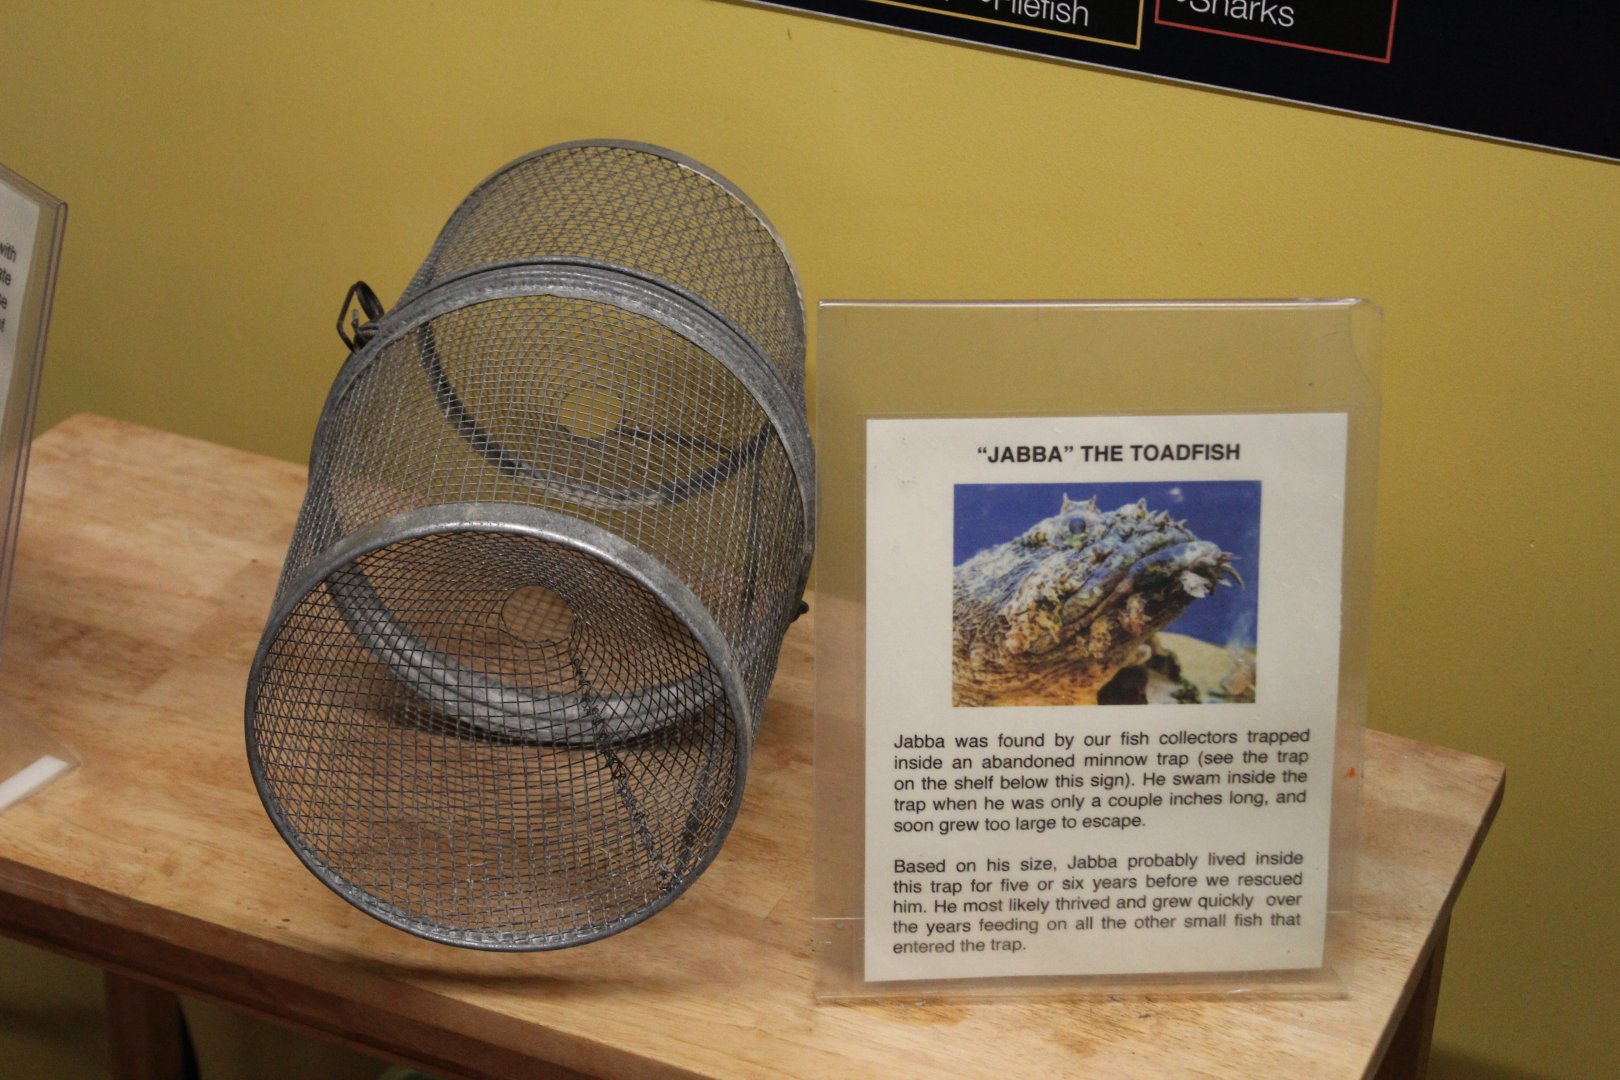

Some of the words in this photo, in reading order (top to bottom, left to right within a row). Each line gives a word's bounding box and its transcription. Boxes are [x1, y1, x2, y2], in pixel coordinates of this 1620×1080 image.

[978, 445, 1074, 463] “JABBA”
[1080, 444, 1123, 462] THE
[1130, 443, 1240, 461] TOADFISH
[894, 733, 945, 749] Jabba
[955, 736, 988, 749] was
[998, 732, 1044, 748] found
[1055, 732, 1074, 750] by
[1084, 734, 1111, 747] our
[1121, 731, 1149, 746] fish
[1159, 730, 1237, 746] collectors
[1248, 728, 1310, 746] trapped
[895, 754, 942, 770] inside
[952, 758, 972, 770] an
[982, 753, 1075, 769] abandoned
[1084, 752, 1148, 767] minnow
[1157, 752, 1189, 768] trap
[1198, 752, 1233, 768] (see
[1243, 750, 1268, 764] the
[1278, 750, 1308, 766] trap
[894, 779, 914, 791] on
[921, 776, 947, 791] the
[954, 775, 993, 790] shelf
[1001, 775, 1048, 790] below
[1055, 773, 1084, 788] this
[1091, 772, 1134, 791] sign).
[1143, 772, 1166, 787] He
[1173, 773, 1220, 786] swam
[1228, 769, 1275, 785] inside
[1282, 770, 1307, 783] the
[894, 798, 926, 814] trap
[933, 797, 976, 811] when
[985, 796, 1004, 811] he
[1012, 798, 1044, 810] was
[1051, 794, 1085, 812] only
[1091, 796, 1101, 808] a
[1108, 792, 1163, 810] couple
[1170, 791, 1222, 806] inches
[1230, 791, 1268, 808] long,
[1276, 789, 1306, 804] and
[894, 820, 933, 833] soon
[939, 820, 979, 836] grew
[985, 818, 1010, 832] too
[1016, 816, 1056, 834] large
[1062, 815, 1077, 829] to
[1082, 816, 1145, 830] escape.
[894, 858, 945, 874] Based
[956, 861, 976, 873] on
[987, 857, 1010, 872] his
[1020, 856, 1056, 872] size,
[1067, 854, 1117, 870] Jabba
[1128, 852, 1198, 871] probably
[1209, 851, 1245, 866] lived
[1256, 850, 1303, 866] inside
[893, 879, 922, 894] this
[930, 880, 962, 896] trap
[971, 878, 992, 893] for
[1001, 878, 1029, 892] five
[1037, 879, 1054, 892] or
[1062, 876, 1084, 891] six
[1093, 877, 1137, 893] years
[1146, 873, 1197, 888] before
[1206, 876, 1229, 887] we
[1238, 871, 1302, 887] rescued
[893, 899, 926, 914] him.
[935, 899, 957, 914] He
[964, 899, 1002, 913] most
[1009, 897, 1049, 915] likely
[1055, 895, 1110, 911] thrived
[1116, 895, 1146, 909] and
[1152, 897, 1192, 912] grew
[1198, 893, 1254, 911] quickly
[1266, 895, 1302, 907] over
[893, 920, 918, 934] the
[926, 922, 971, 937] years
[979, 918, 1039, 934] feeding
[1047, 920, 1067, 931] on
[1075, 916, 1093, 930] all
[1101, 916, 1126, 930] the
[1134, 914, 1176, 929] other
[1184, 914, 1226, 928] small
[1234, 913, 1262, 927] fish
[1270, 913, 1301, 927] that
[893, 940, 955, 954] entered
[960, 938, 985, 952] the
[991, 939, 1026, 954] trap.
